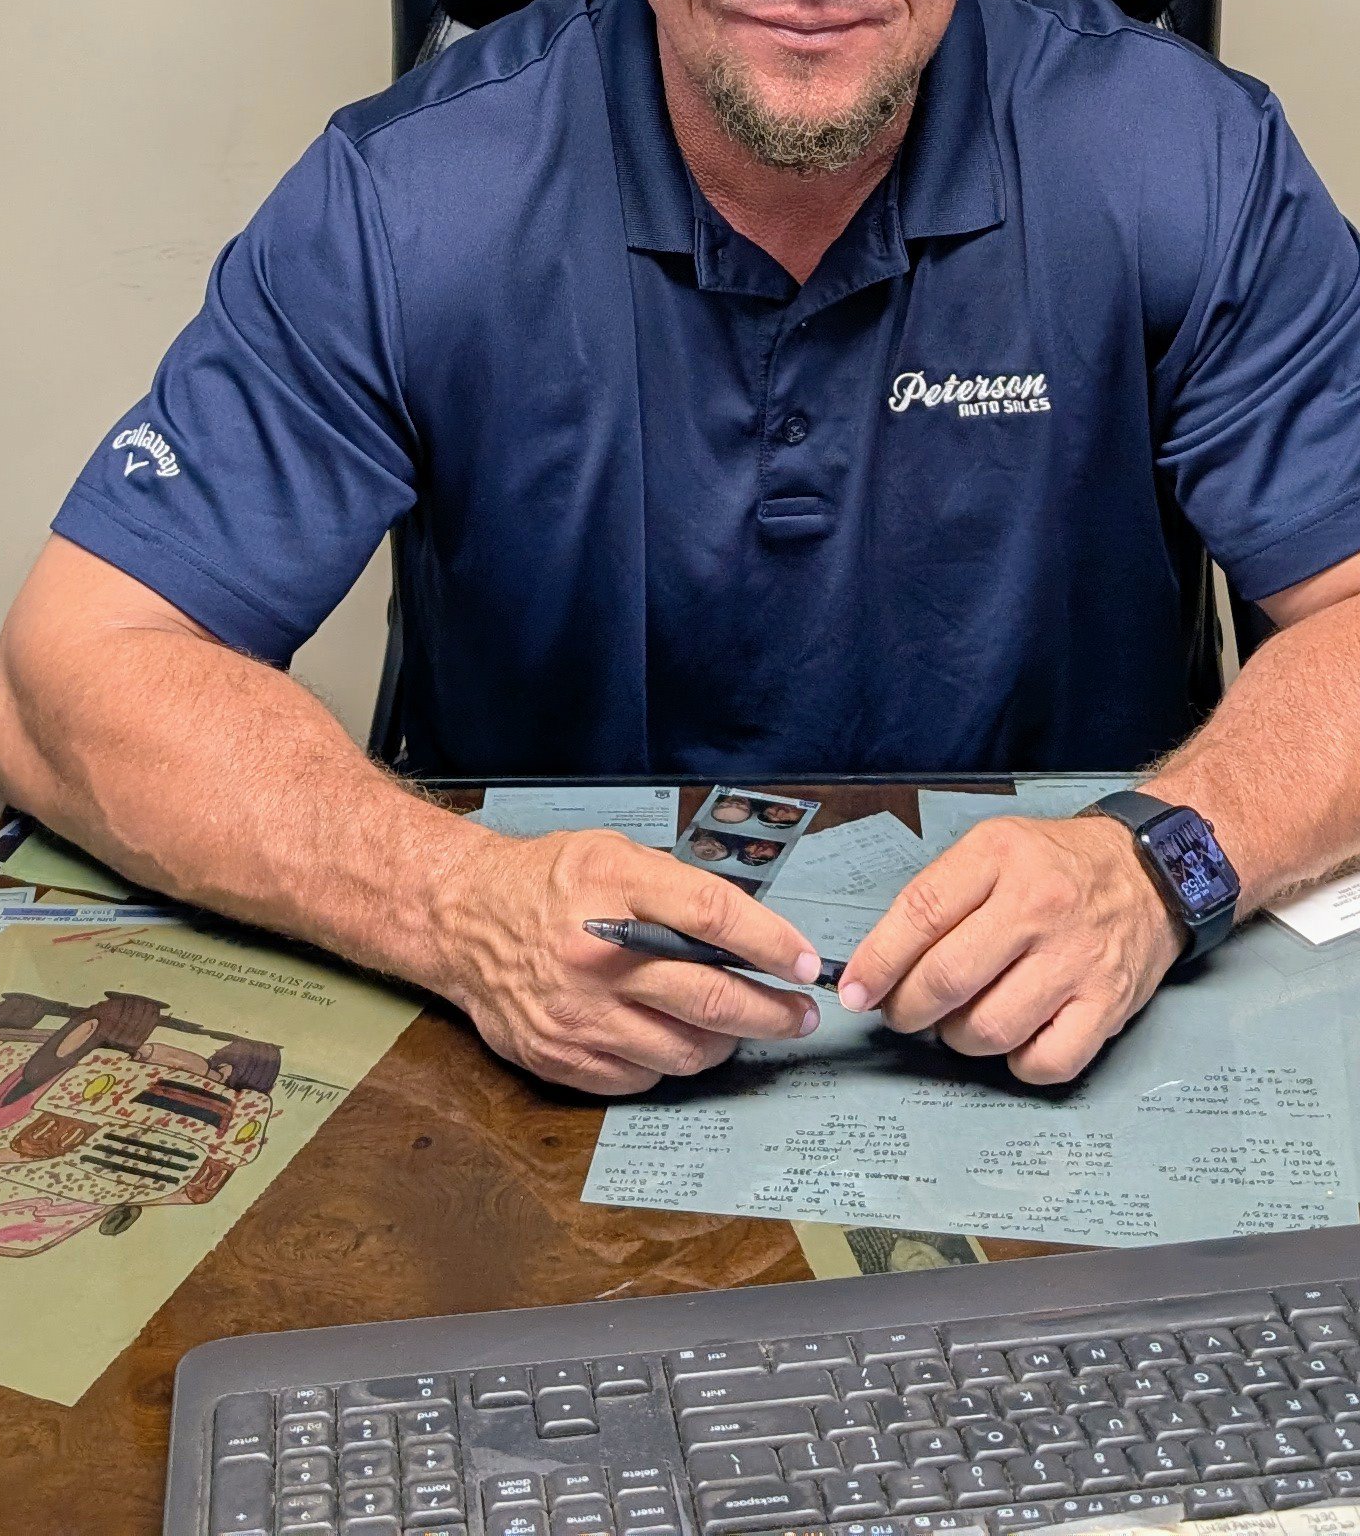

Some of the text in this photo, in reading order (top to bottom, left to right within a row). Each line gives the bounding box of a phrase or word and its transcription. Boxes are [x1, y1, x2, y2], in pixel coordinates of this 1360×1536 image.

[888, 370, 1047, 412] Peterson
[958, 397, 1051, 417] AUTO SALES
[113, 422, 181, 477] Callaway
[246, 964, 269, 980] and
[225, 973, 246, 987] and
[249, 979, 272, 992] cars
[305, 978, 325, 992] sell
[274, 984, 299, 999] with
[301, 986, 336, 1006] Along
[891, 1334, 905, 1342] alt
[707, 1351, 726, 1360] ctrl
[418, 1377, 434, 1385] ins
[296, 1389, 314, 1399] del
[700, 1389, 726, 1398] shift
[417, 1411, 439, 1420] end
[709, 1424, 740, 1433] enter
[228, 1436, 259, 1447] enter
[622, 1468, 659, 1479] delete
[498, 1478, 531, 1488] down
[566, 1475, 590, 1485] end
[416, 1484, 451, 1495] home
[500, 1485, 531, 1496] page
[725, 1495, 789, 1509] backspace
[629, 1506, 665, 1517] insert
[510, 1517, 526, 1526] up
[566, 1513, 601, 1524] home
[504, 1524, 535, 1535] page
